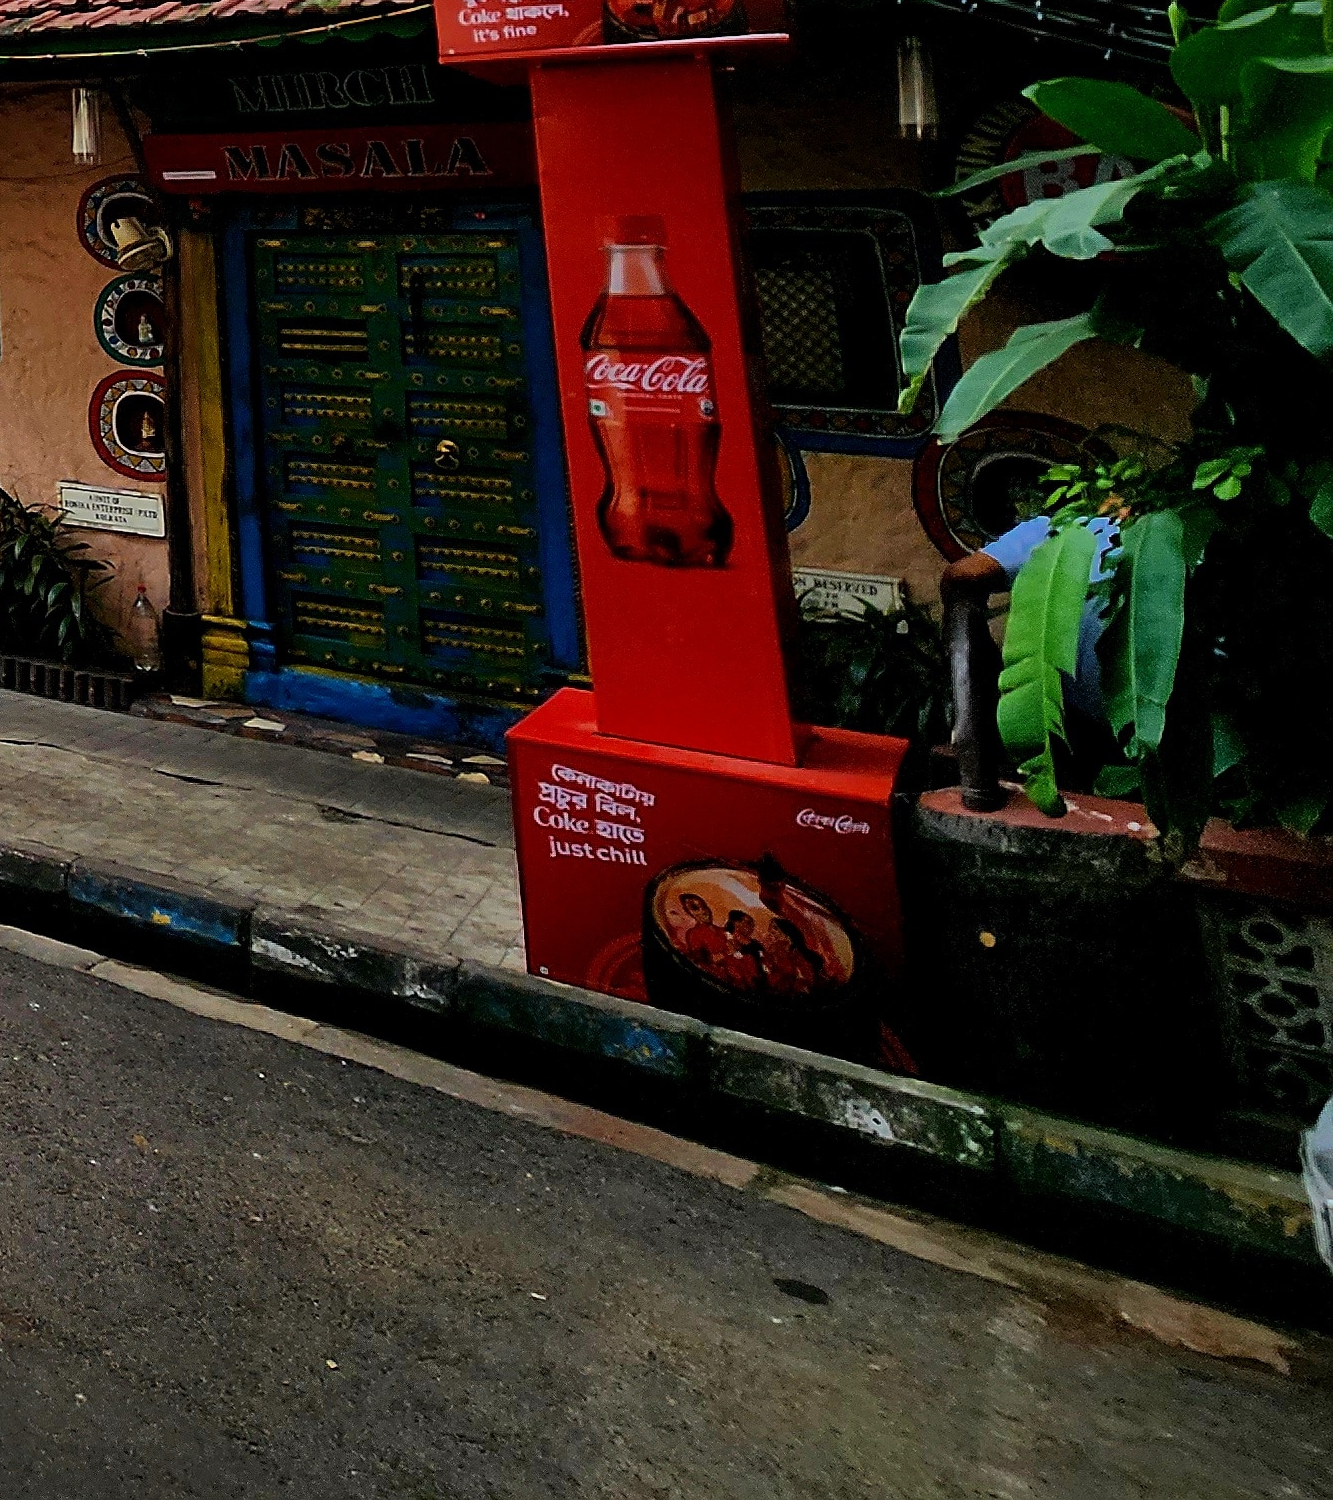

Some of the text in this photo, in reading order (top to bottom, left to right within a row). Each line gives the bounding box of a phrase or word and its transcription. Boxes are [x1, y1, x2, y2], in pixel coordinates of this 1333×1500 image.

[458, 8, 502, 26] Coke
[503, 25, 538, 39] fine
[228, 63, 435, 112] MIRCH
[223, 136, 494, 182] MASALA
[585, 354, 709, 393] Coca-Cola
[533, 806, 591, 835] Coke
[548, 835, 648, 867] just chill
